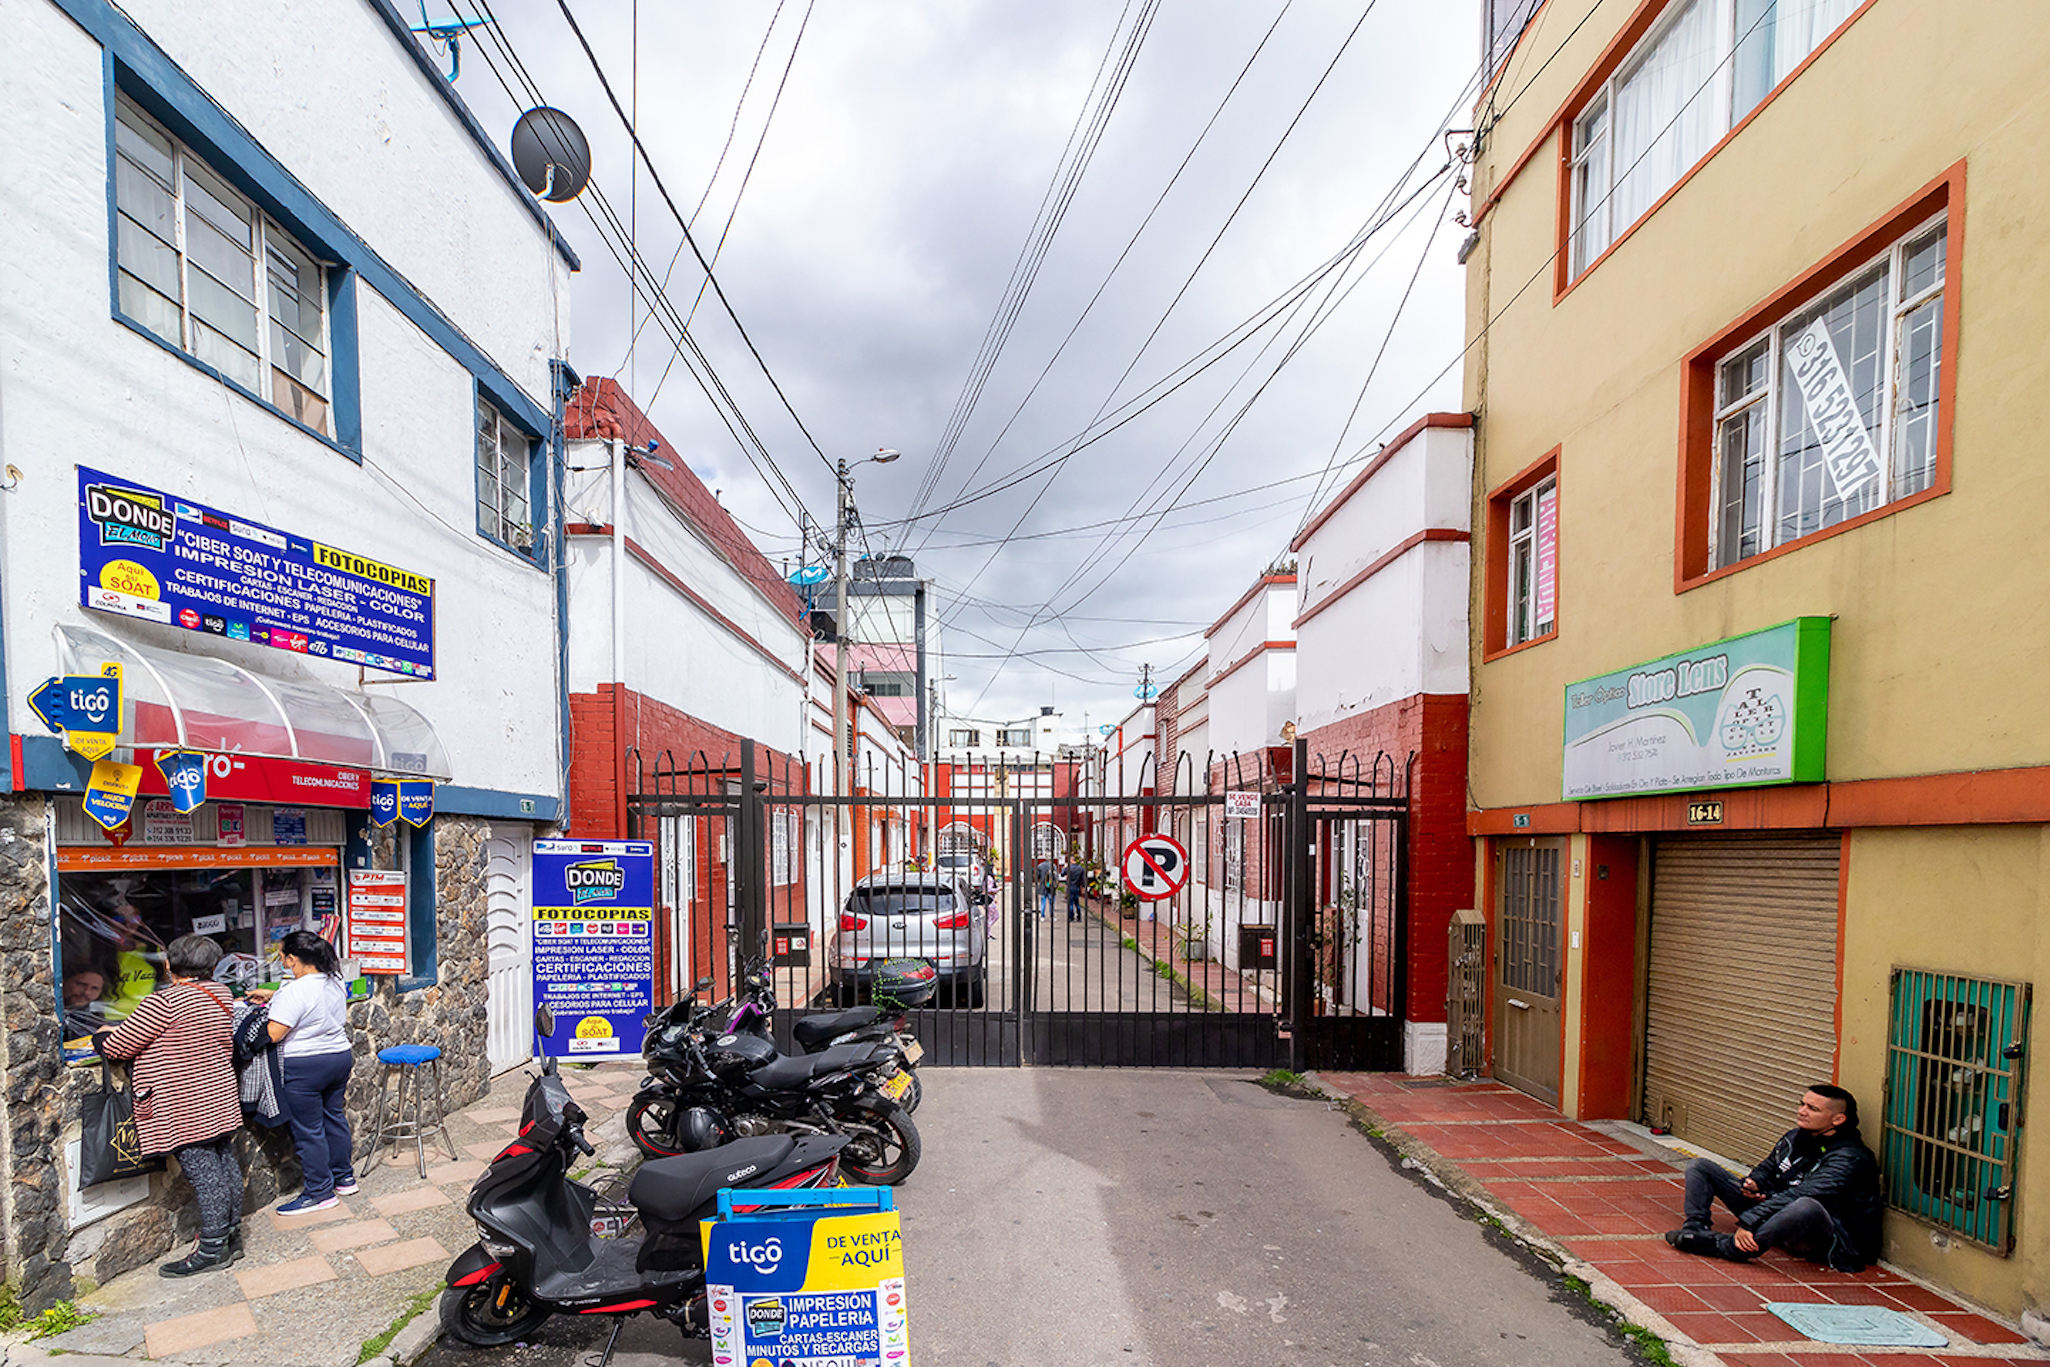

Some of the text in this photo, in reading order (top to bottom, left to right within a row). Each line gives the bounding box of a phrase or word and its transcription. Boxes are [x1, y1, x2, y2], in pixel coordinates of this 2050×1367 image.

[1797, 341, 1838, 402] 316
[91, 491, 172, 535] DONDE
[233, 546, 270, 568] SOAT
[272, 557, 281, 571] Y
[319, 547, 428, 594] FOTOCOPIAS
[110, 576, 152, 596] SOAT
[174, 545, 425, 623] IMPRESION LASER COLOR
[174, 568, 418, 639] CERTIFICACIONES PAPELERIA PLASTIFICADOS
[165, 581, 430, 653] TRABAJOS DE INTERNET EPS ACCESORIOS PARA CELULAR
[103, 666, 118, 678] 4G
[1628, 668, 1677, 709] Store
[1677, 654, 1728, 698] Lens
[568, 869, 621, 887] DONDE
[538, 909, 649, 919] FOTOCOPIAS
[535, 946, 651, 954] IMPRESION LASER COLOR
[536, 962, 652, 973] CERTIFICACIONES
[591, 1000, 612, 1008] PARA
[613, 999, 649, 1007] CELULAR
[827, 1229, 901, 1248] DE VENTA
[789, 1291, 871, 1312] IMPRESIÓN
[750, 1308, 784, 1320] DONDE
[789, 1310, 874, 1329] PAPELERIA
[779, 1329, 878, 1345] CARTAS-ESCANER
[747, 1345, 800, 1357] MINUTOS
[802, 1343, 810, 1356] Y
[813, 1341, 878, 1356] RECARGAS
